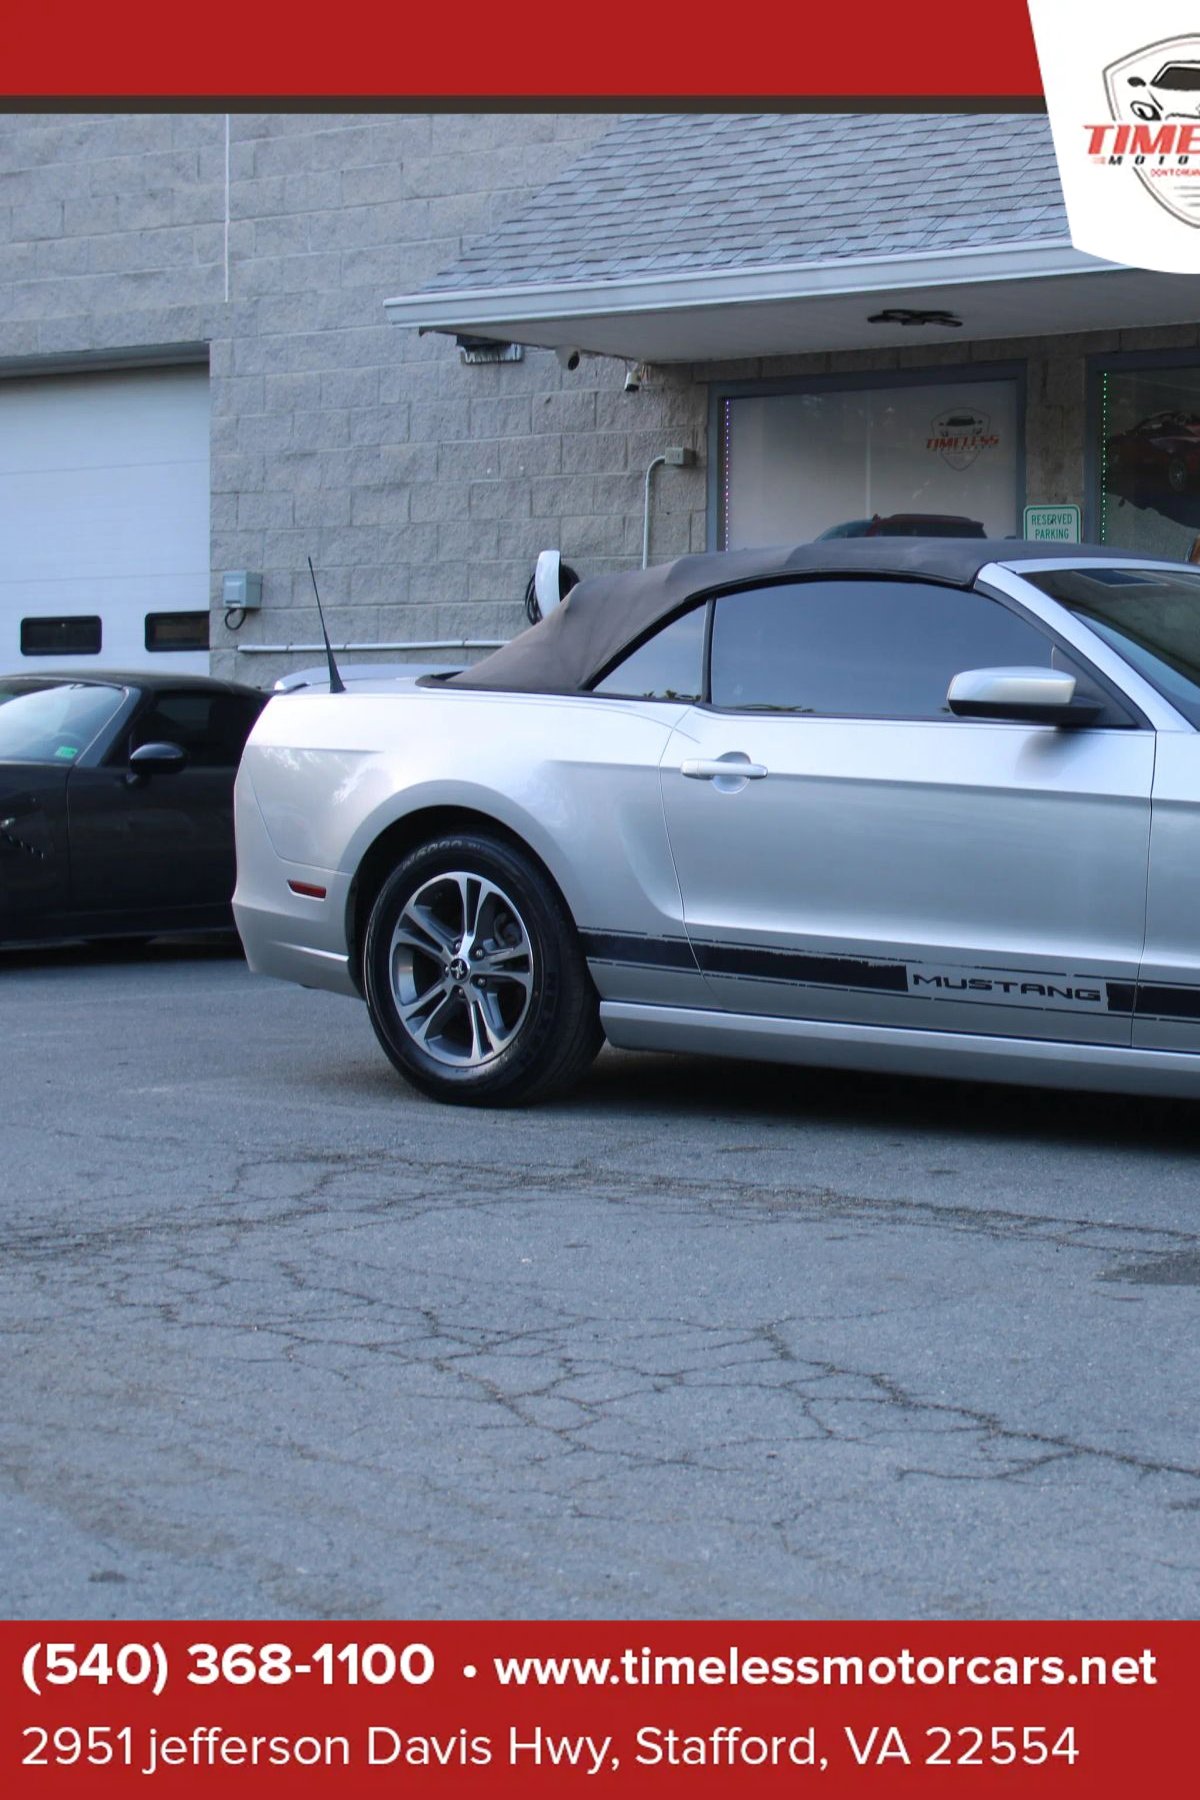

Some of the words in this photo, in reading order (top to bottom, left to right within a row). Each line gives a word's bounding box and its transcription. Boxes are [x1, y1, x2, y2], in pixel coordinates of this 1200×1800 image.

[1031, 513, 1073, 525] RESERVED
[1035, 528, 1069, 540] PARKING
[913, 974, 1101, 1001] MUSTANG
